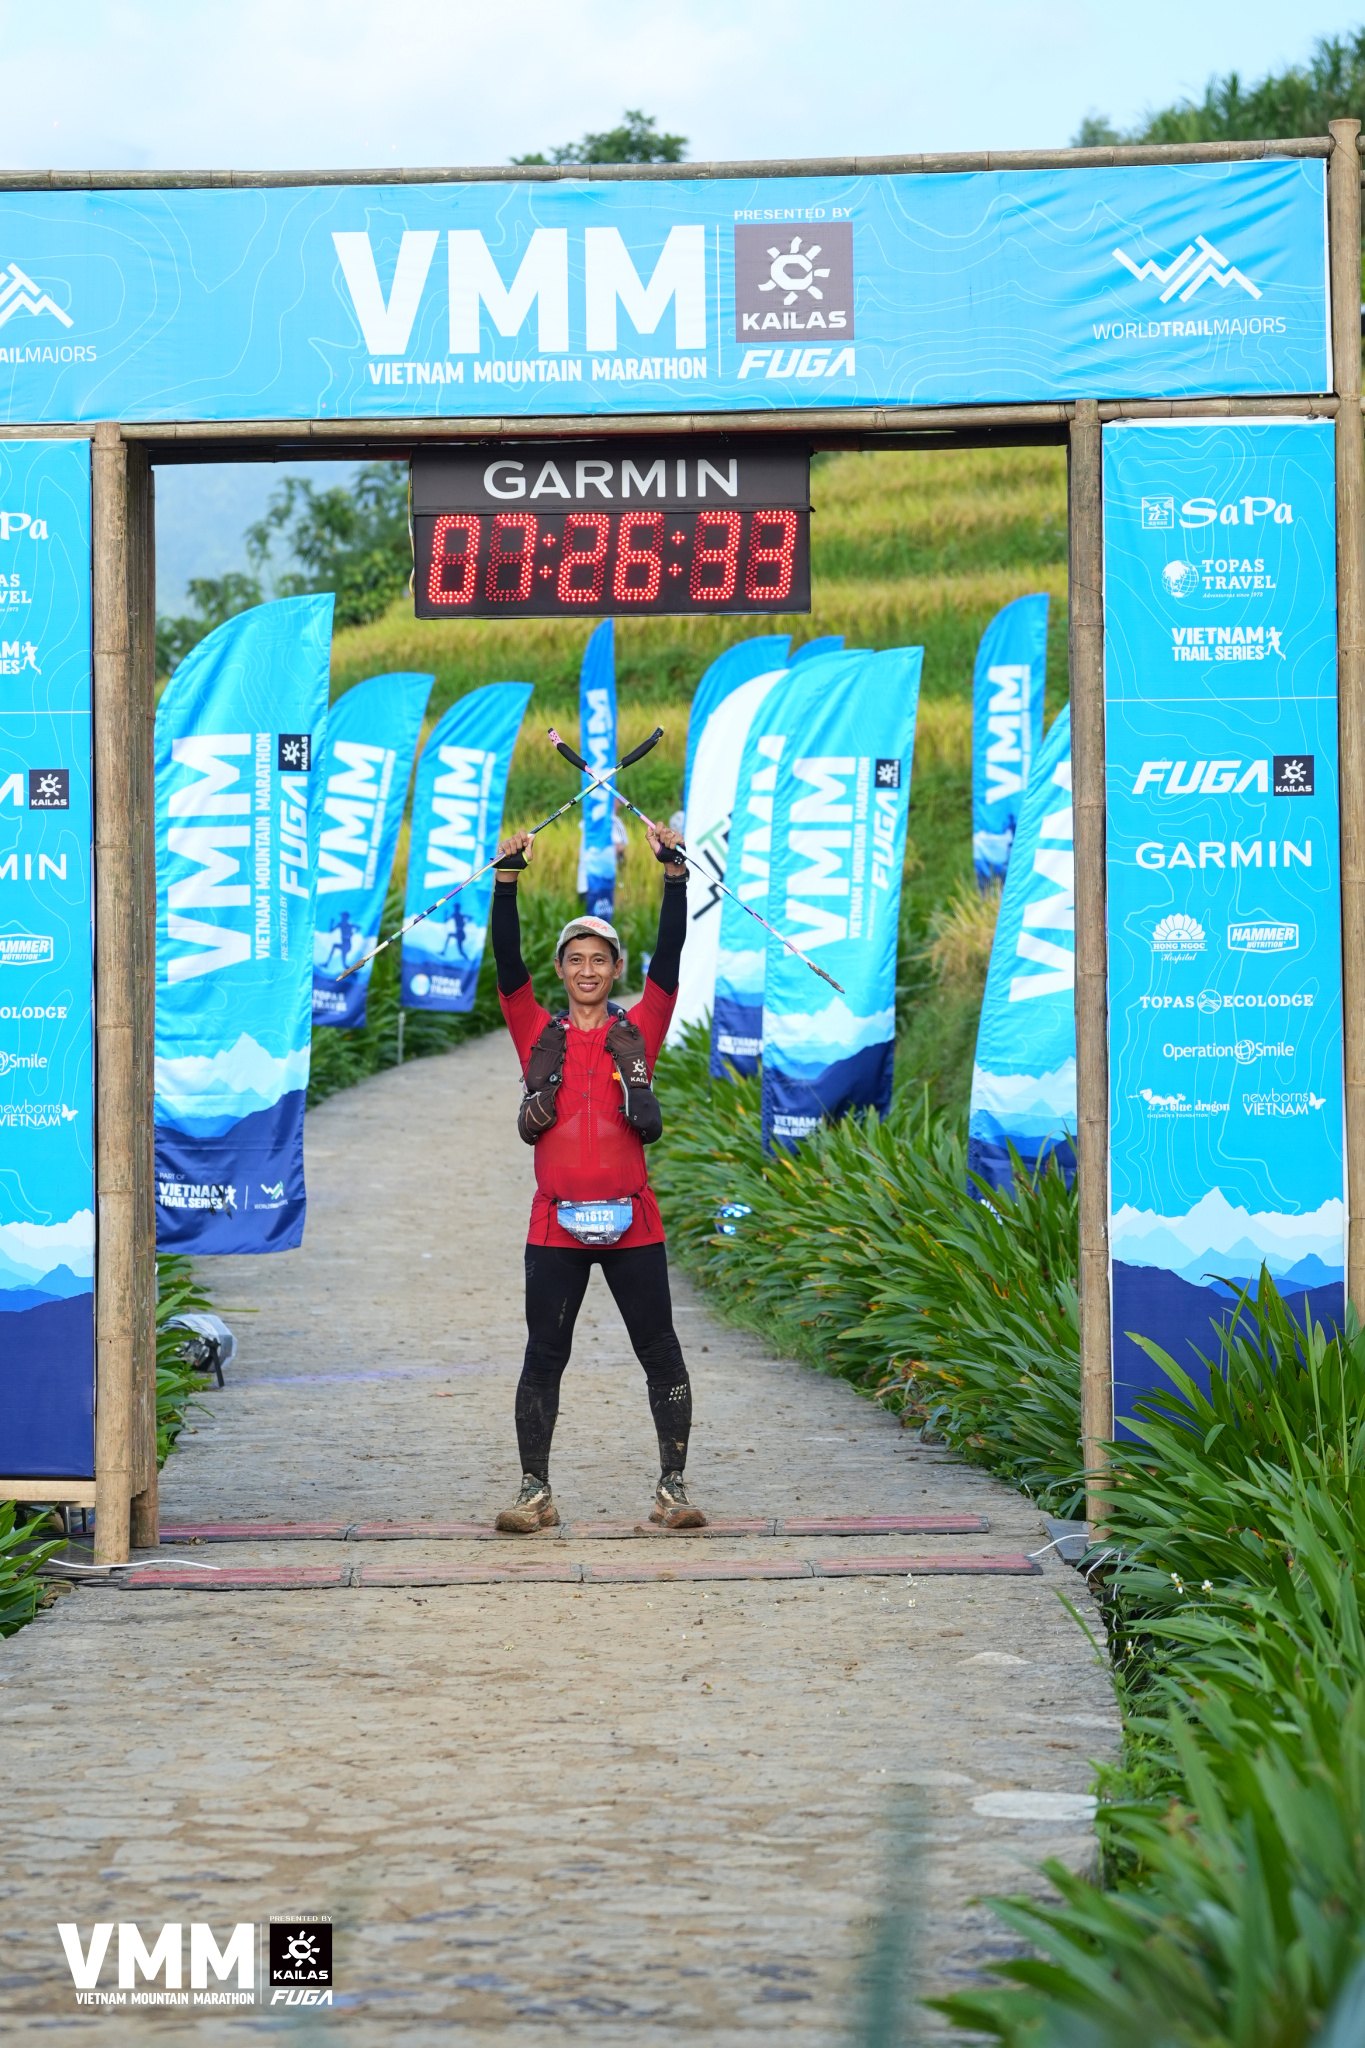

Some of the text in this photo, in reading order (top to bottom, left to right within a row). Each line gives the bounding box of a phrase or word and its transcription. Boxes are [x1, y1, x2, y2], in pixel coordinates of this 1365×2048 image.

[734, 206, 853, 220] PRESENTED BY
[332, 225, 706, 356] VMM
[742, 311, 847, 331] KAILAS
[1093, 317, 1287, 341] WORLDTRAILMAJORS
[368, 357, 707, 385] VIETNAM MOUNTAIN MARATHON
[737, 348, 855, 379] FUGA
[483, 458, 738, 499] GARMIN
[1179, 496, 1294, 528] SaPa
[428, 511, 797, 603] 07:26:33
[1202, 559, 1264, 573] TOPAS
[1202, 576, 1276, 589] TRAVEL
[1172, 627, 1264, 645] VIETNAM
[1172, 645, 1265, 661] TRAIL SERIES
[986, 664, 1023, 805] VMM
[301, 735, 309, 771] KAILAS
[1132, 760, 1268, 795] FUGA
[1275, 785, 1312, 793] KAILAS
[317, 741, 386, 895] VMM
[424, 745, 486, 889] VMM
[256, 732, 271, 961] VIETNAM MOUNTAIN MARATHON
[279, 775, 309, 900] FUGA
[871, 791, 899, 891] FUGA
[168, 733, 251, 985] VMM
[784, 756, 856, 953] VMM
[1135, 840, 1312, 869] GARMIN
[1232, 928, 1295, 941] HAMMER
[1161, 952, 1197, 965] Hospital
[1140, 994, 1313, 1009] TOPAS ECOLODGE
[10, 1053, 48, 1068] Smile
[1163, 1041, 1295, 1061] Operation Smile
[1170, 1099, 1230, 1113] blue dragon
[1242, 1088, 1309, 1103] newborns
[1243, 1102, 1309, 1116] VIETNAM
[159, 1195, 187, 1208] TRAIL
